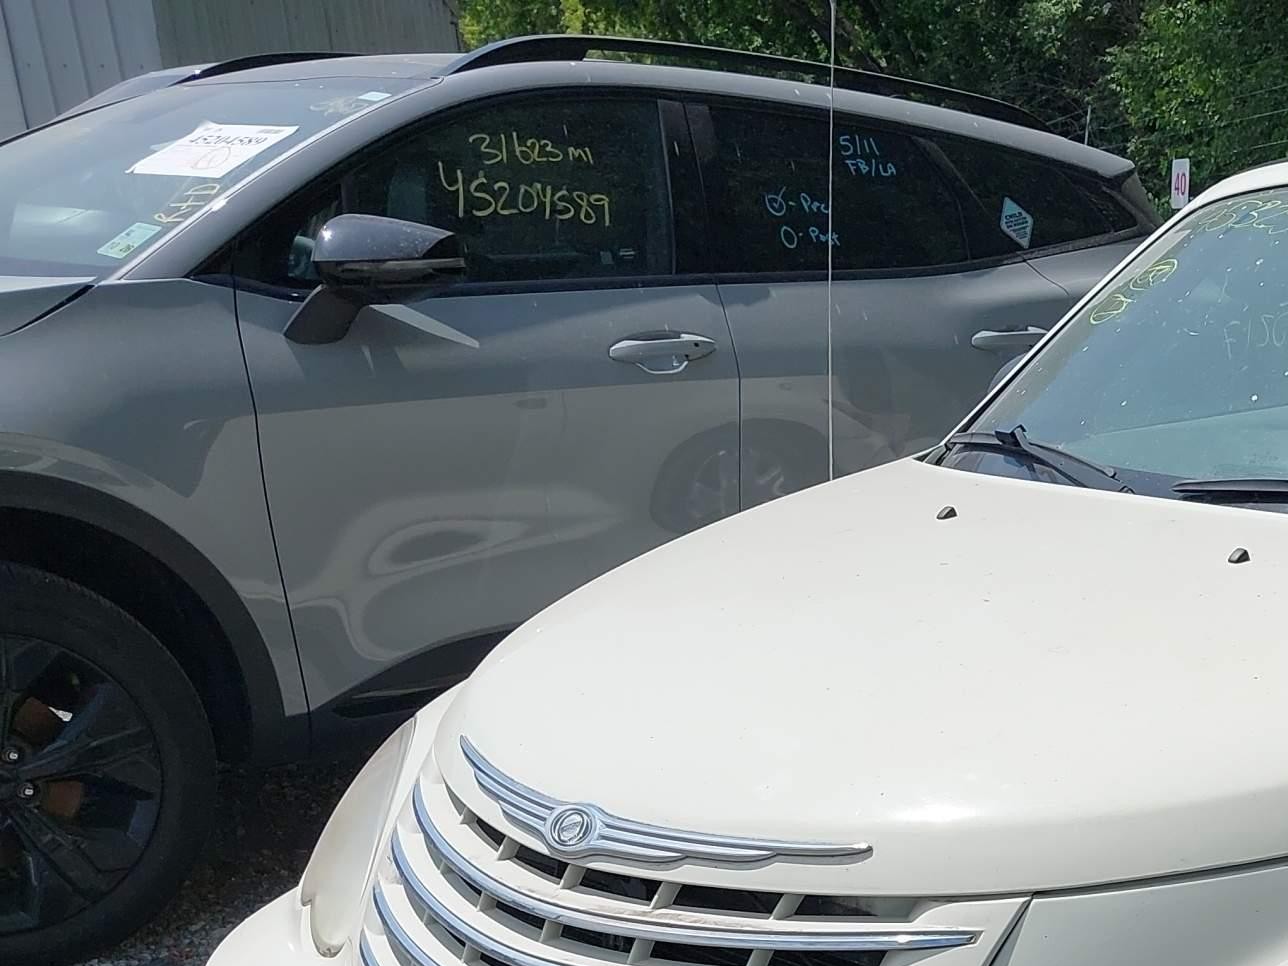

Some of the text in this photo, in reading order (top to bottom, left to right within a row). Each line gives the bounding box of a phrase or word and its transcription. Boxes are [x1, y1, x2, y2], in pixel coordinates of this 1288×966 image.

[839, 134, 880, 156] 5/11
[438, 160, 610, 227] 45204589
[1174, 172, 1187, 196] 40
